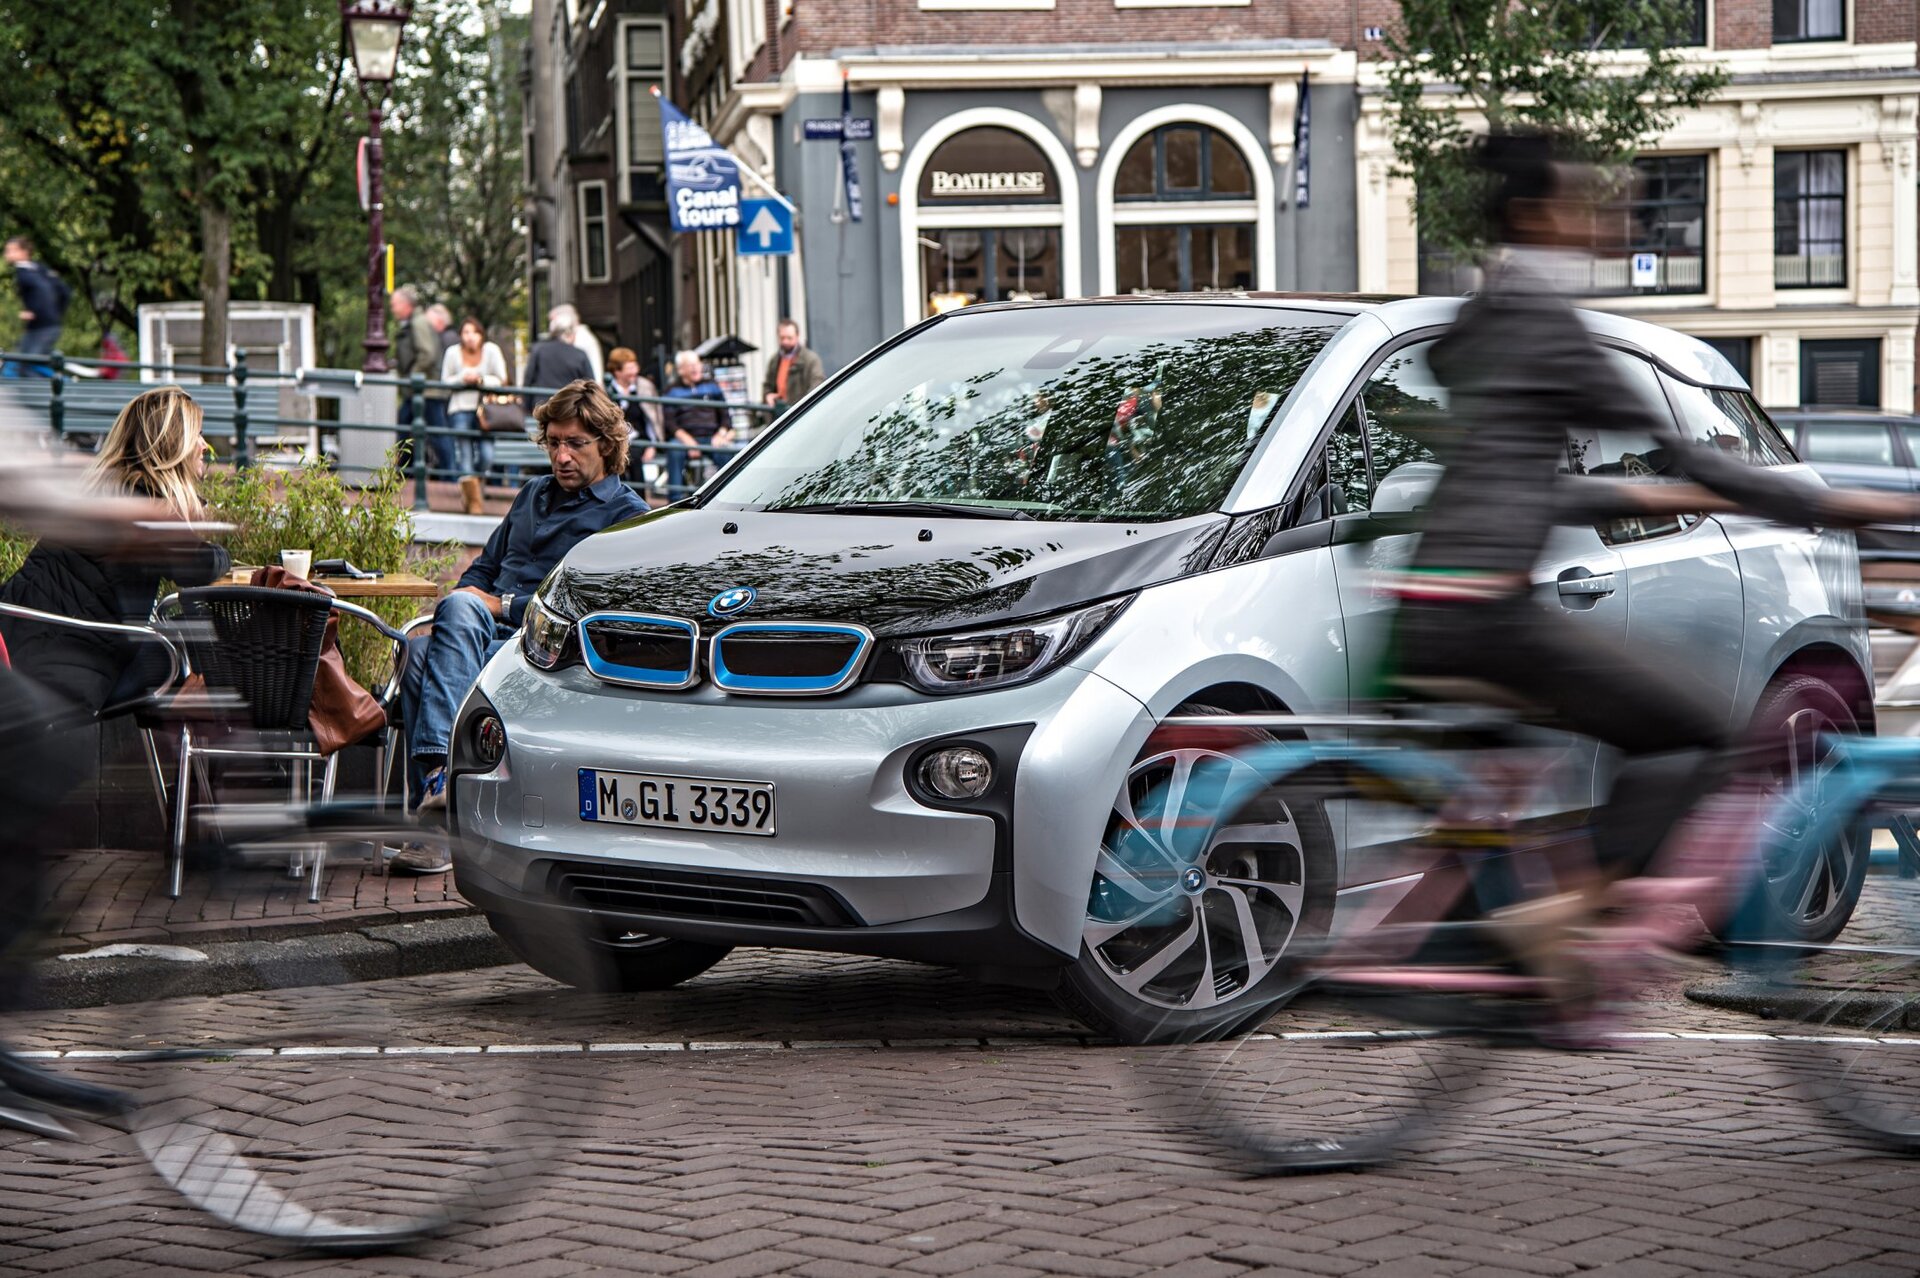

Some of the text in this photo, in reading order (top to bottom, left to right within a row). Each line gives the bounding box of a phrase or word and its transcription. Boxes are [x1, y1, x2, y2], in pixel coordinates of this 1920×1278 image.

[931, 171, 1045, 192] BOATHOUSE
[676, 185, 738, 208] Canal
[678, 207, 740, 227] tours
[585, 800, 592, 811] D
[640, 780, 679, 822] GI
[689, 785, 771, 828] 3339
